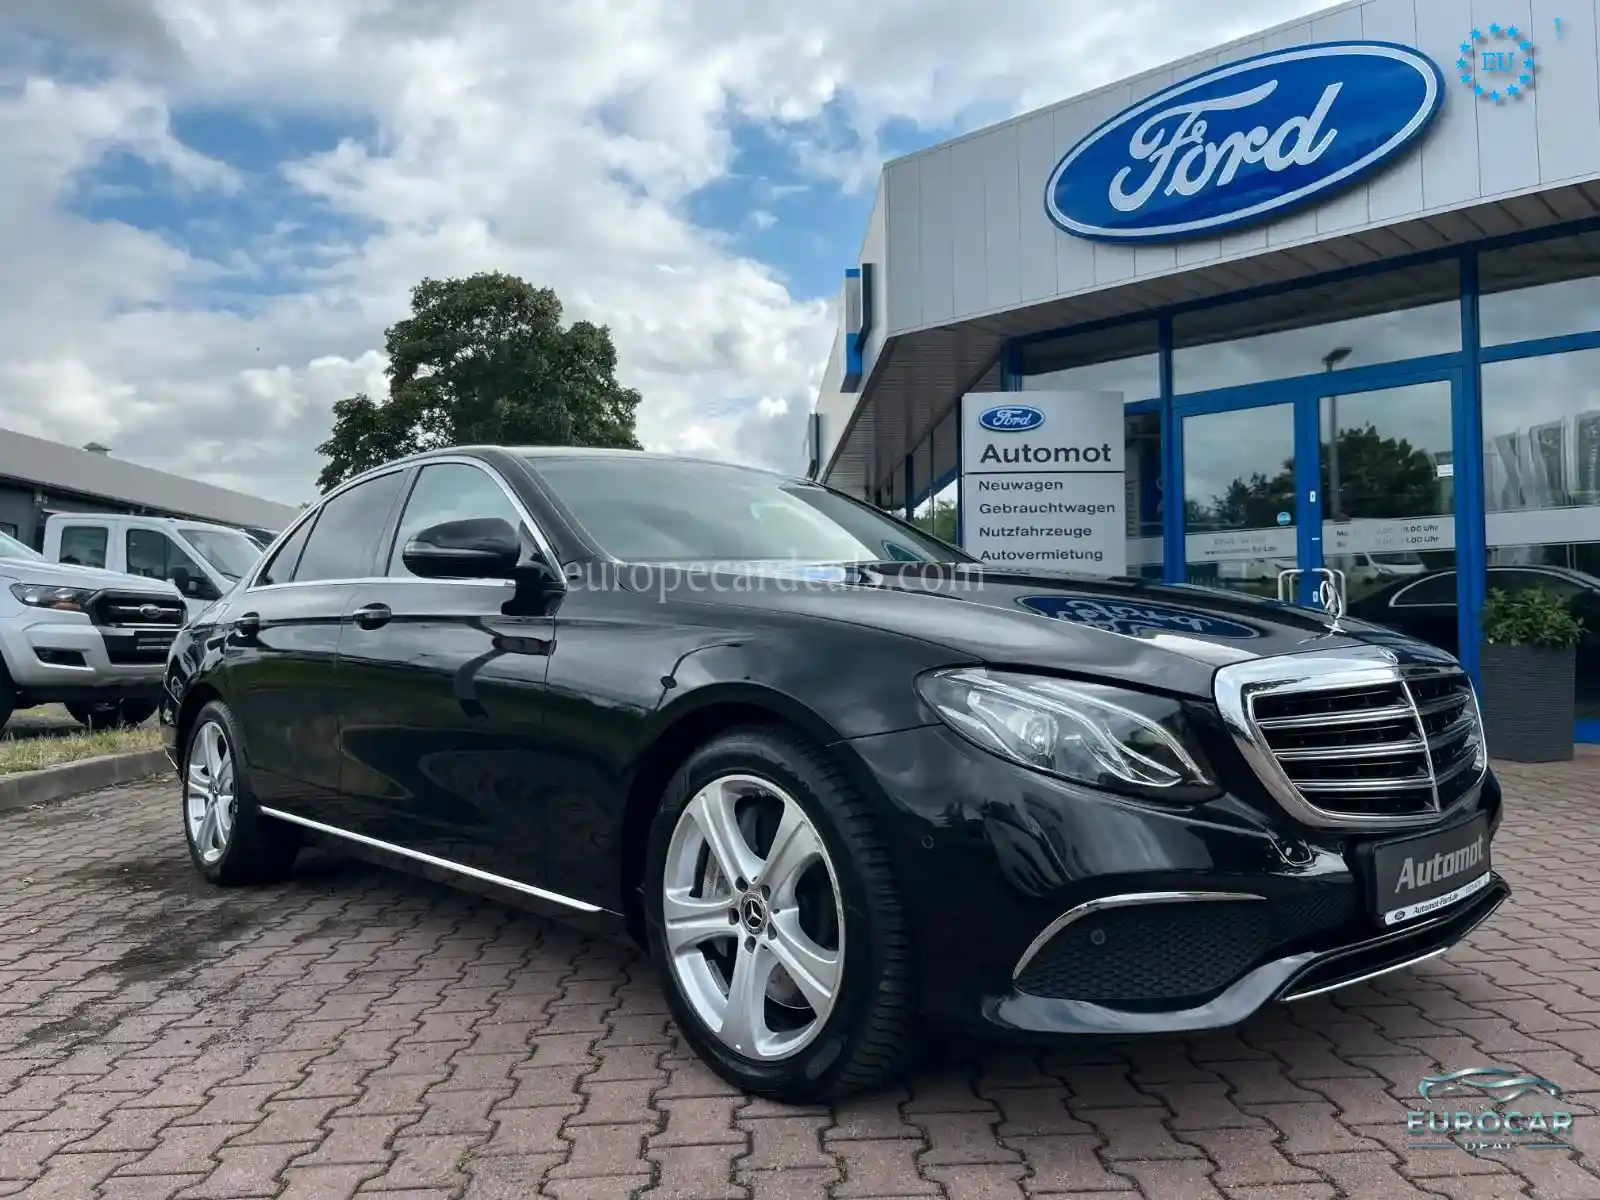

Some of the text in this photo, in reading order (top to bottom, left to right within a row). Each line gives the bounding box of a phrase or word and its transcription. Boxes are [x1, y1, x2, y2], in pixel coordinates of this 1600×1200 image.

[1108, 79, 1344, 212] Ford
[992, 408, 1032, 427] Ford
[980, 443, 1112, 463] Automot
[978, 480, 1064, 492] Neuwagen
[979, 502, 1115, 515] Gebrauchtwagen
[979, 526, 1092, 538] Nutzfahrzeuge
[980, 549, 1103, 562] Autovermietung
[1394, 834, 1484, 894] Automot
